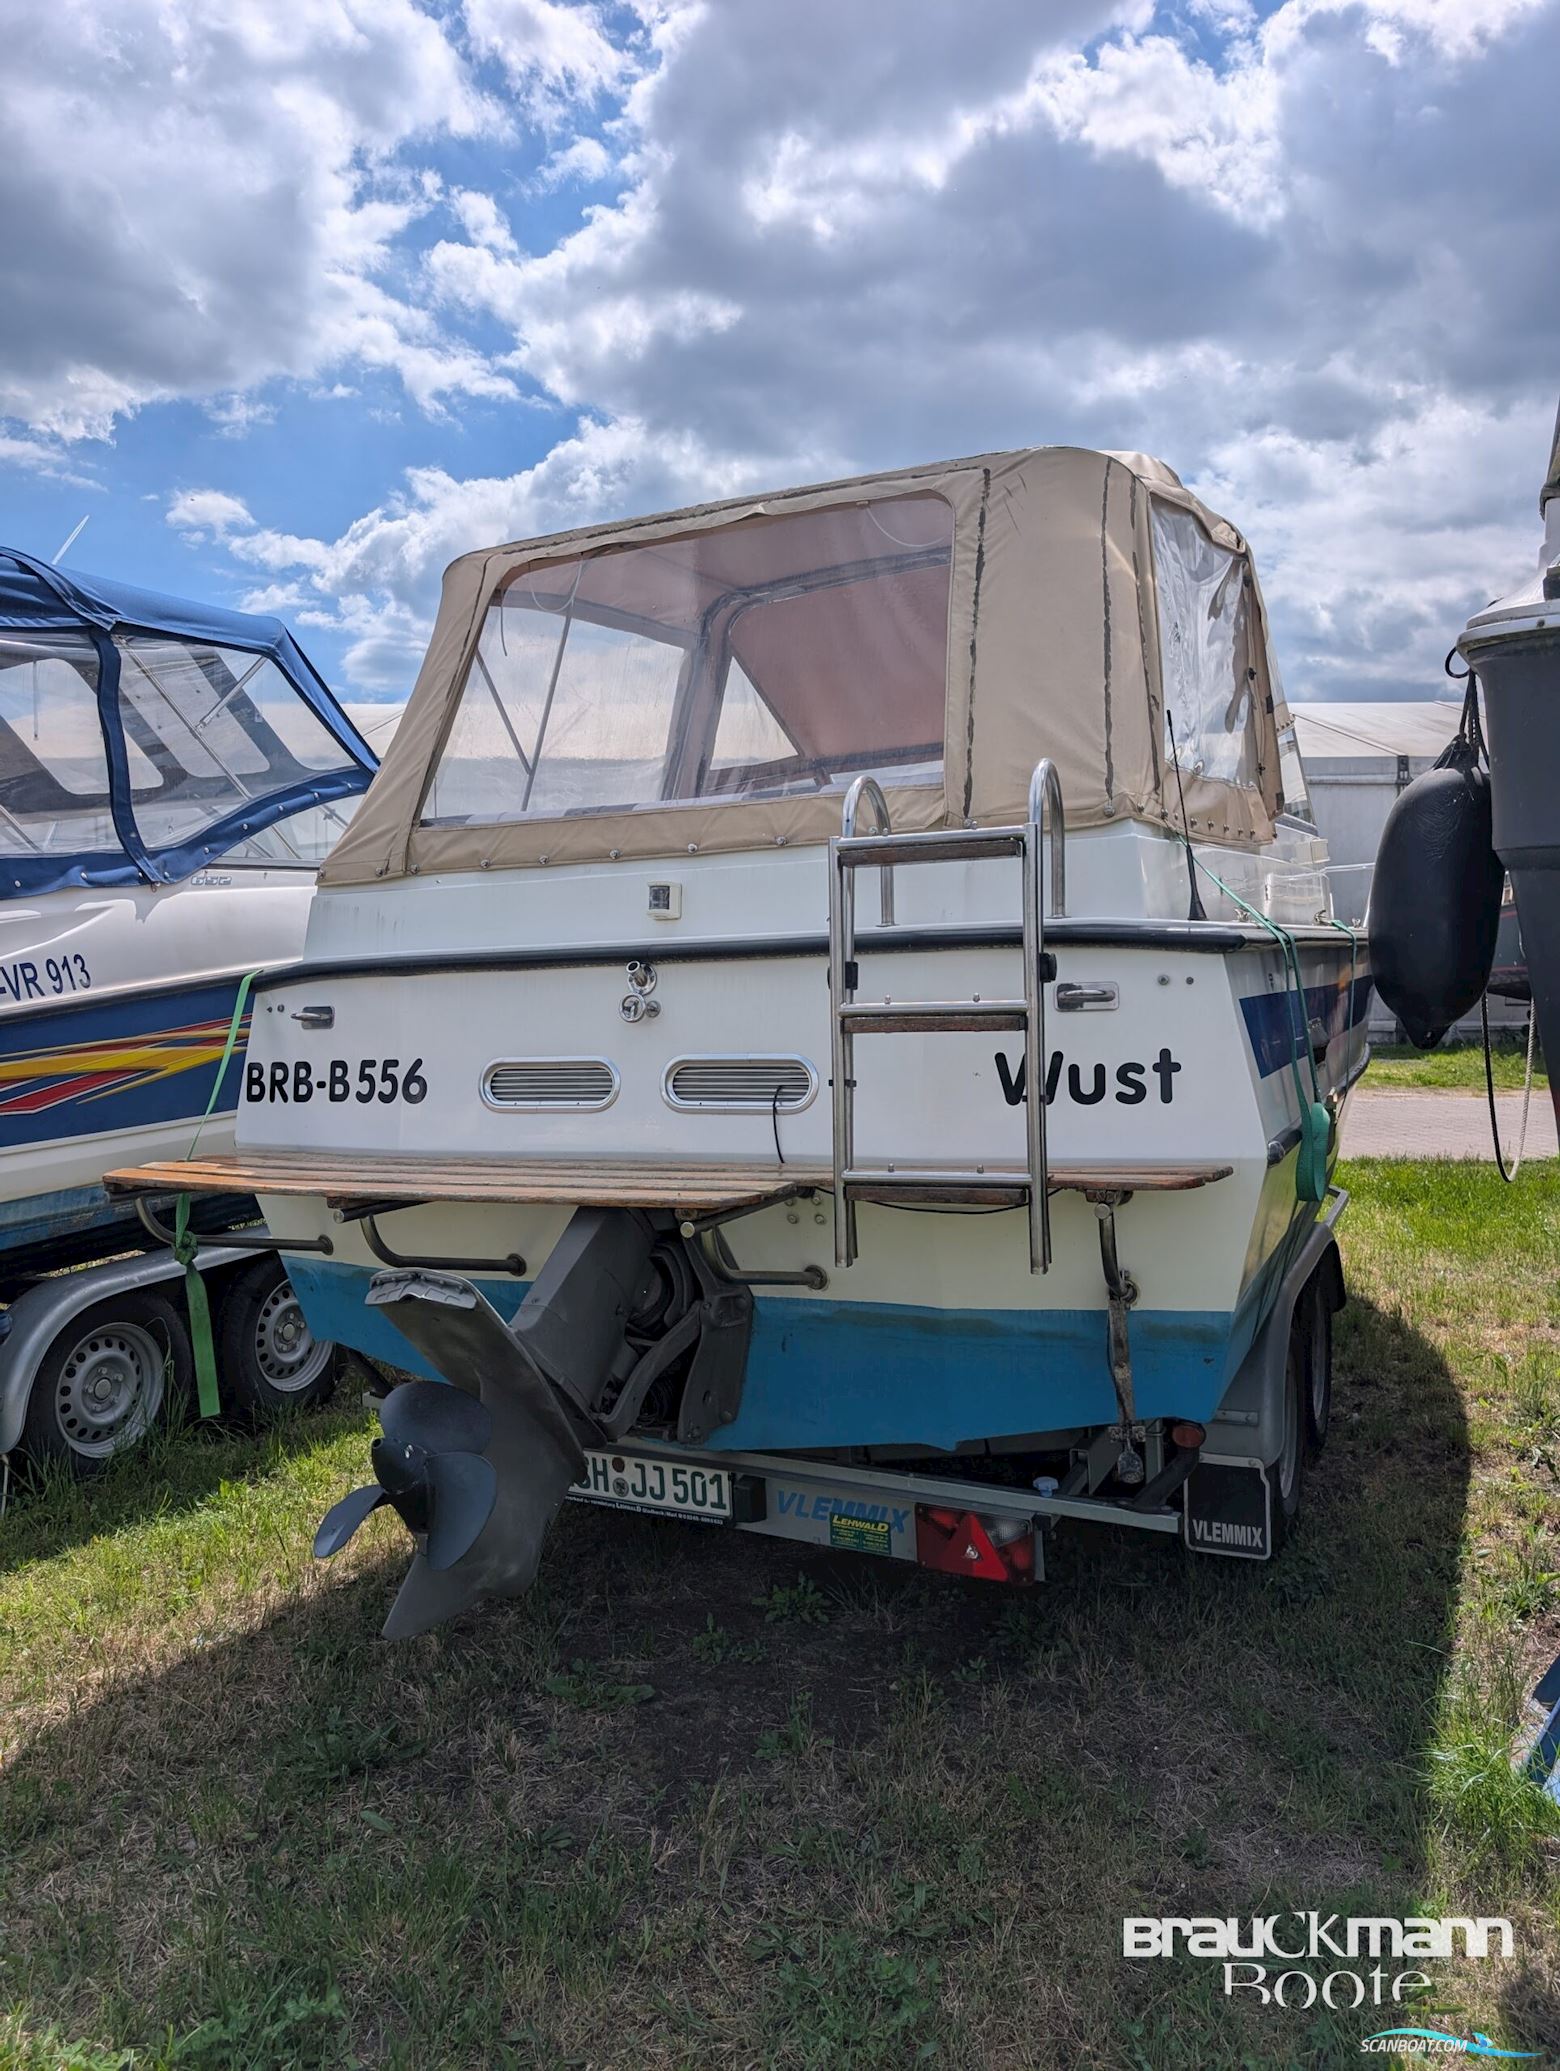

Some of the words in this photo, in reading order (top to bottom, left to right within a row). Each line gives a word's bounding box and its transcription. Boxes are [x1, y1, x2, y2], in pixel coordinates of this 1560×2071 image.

[46, 953, 91, 994] 913
[995, 1048, 1181, 1105] Wust
[672, 1468, 727, 1510] 501
[777, 1489, 910, 1533] VLEMMIX
[1193, 1519, 1263, 1548] VLEMMIX
